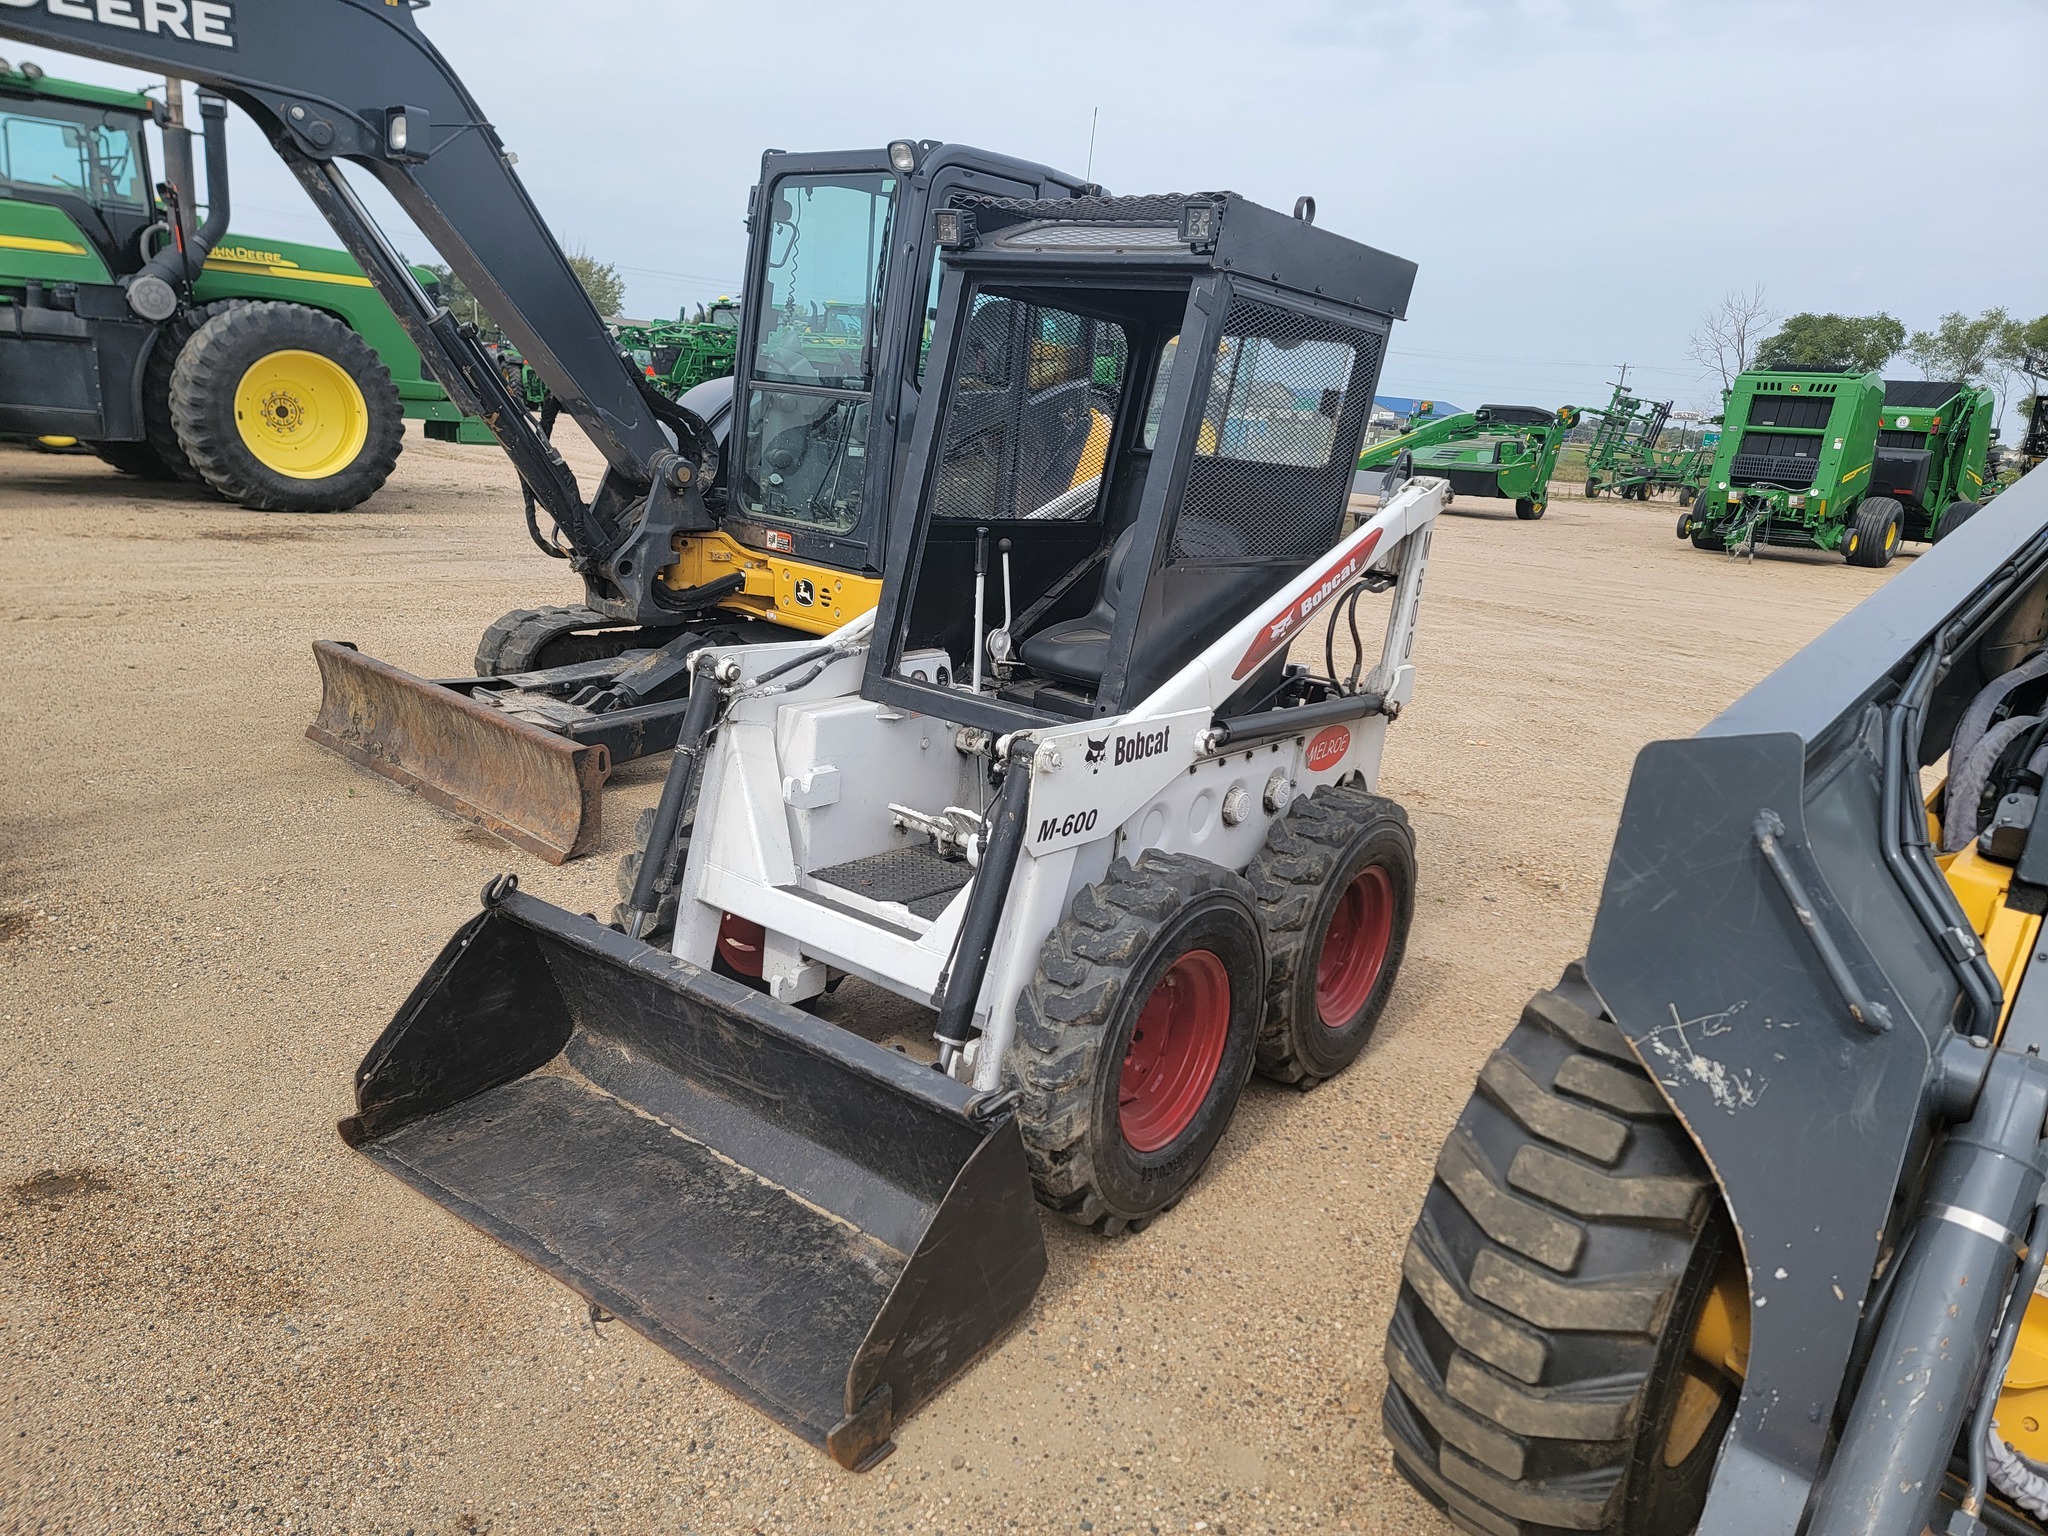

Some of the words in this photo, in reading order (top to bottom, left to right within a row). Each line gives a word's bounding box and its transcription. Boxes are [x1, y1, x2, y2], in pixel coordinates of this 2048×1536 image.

[236, 246, 281, 263] DEERE
[1301, 557, 1357, 617] Bobcat
[1114, 725, 1170, 766] Bobcat
[1306, 733, 1349, 762] MELROE
[1036, 808, 1098, 843] M-600
